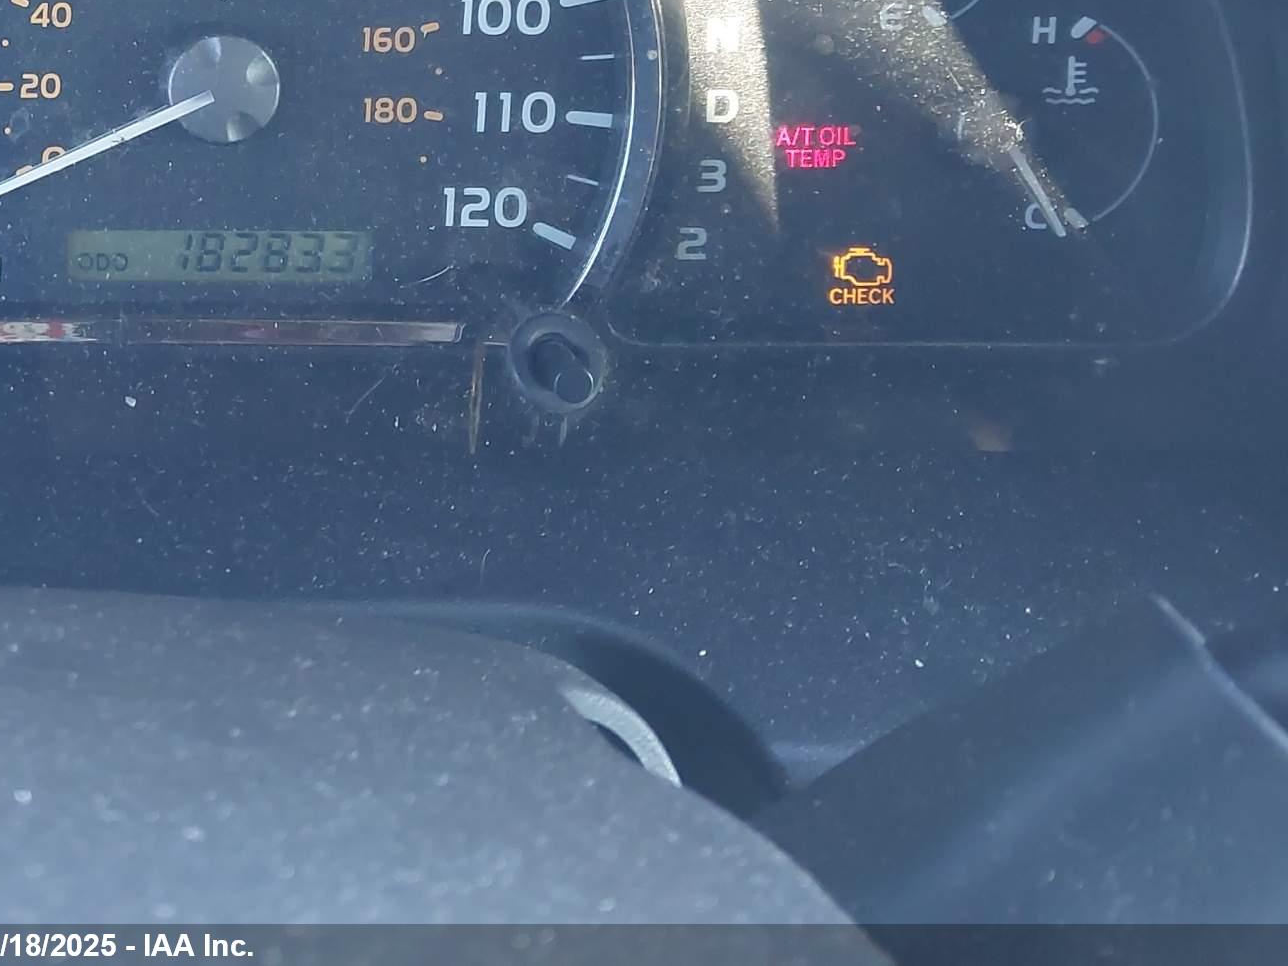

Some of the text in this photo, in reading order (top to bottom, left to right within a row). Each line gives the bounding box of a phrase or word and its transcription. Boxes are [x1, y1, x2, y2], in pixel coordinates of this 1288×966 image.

[31, 2, 73, 29] 40
[363, 27, 416, 53] 160
[1031, 16, 1057, 44] H
[19, 74, 62, 100] 20
[363, 98, 418, 124] 180
[474, 92, 556, 134] 110
[706, 90, 739, 123] D
[819, 126, 857, 147] OIL
[785, 148, 846, 169] TEMP
[697, 159, 727, 193] 3
[443, 187, 527, 228] 120
[179, 232, 358, 273] 182833
[677, 227, 708, 260] 2
[829, 287, 895, 306] CHECK
